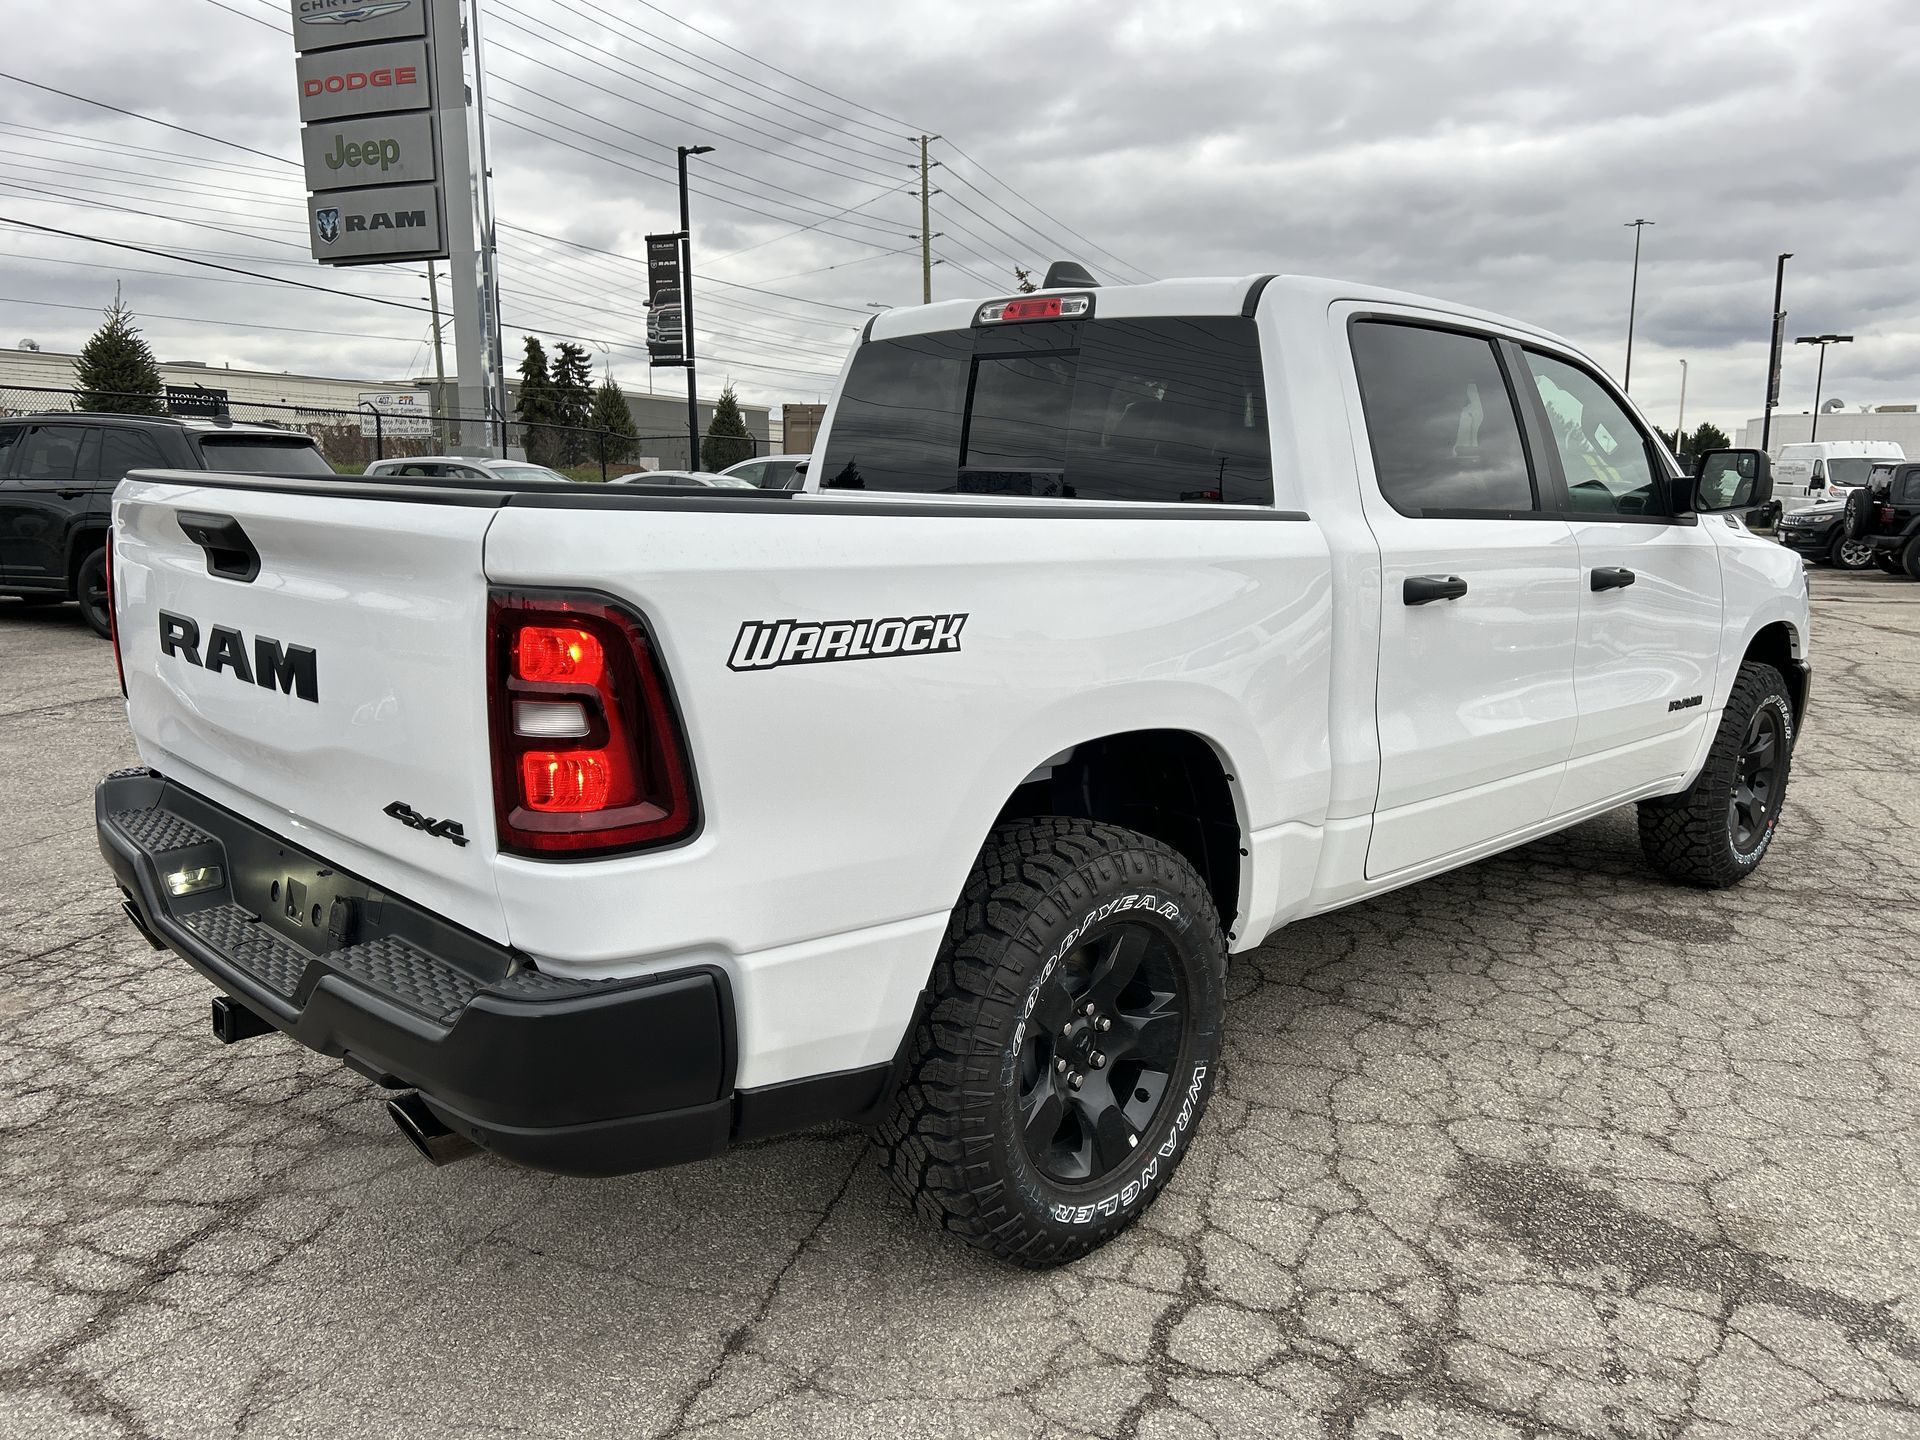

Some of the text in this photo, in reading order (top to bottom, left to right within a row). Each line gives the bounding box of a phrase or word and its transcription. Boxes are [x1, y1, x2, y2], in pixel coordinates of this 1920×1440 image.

[304, 67, 417, 97] DODGE
[325, 134, 400, 171] Jeep
[345, 210, 427, 232] RAM
[379, 395, 414, 406] 407 ETR
[158, 608, 319, 704] RAM
[726, 613, 969, 672] WARLOCK
[1667, 695, 1703, 712] RAM
[1012, 894, 1180, 1057] GOODYEAR
[1054, 1065, 1207, 1225] WRANGLER
